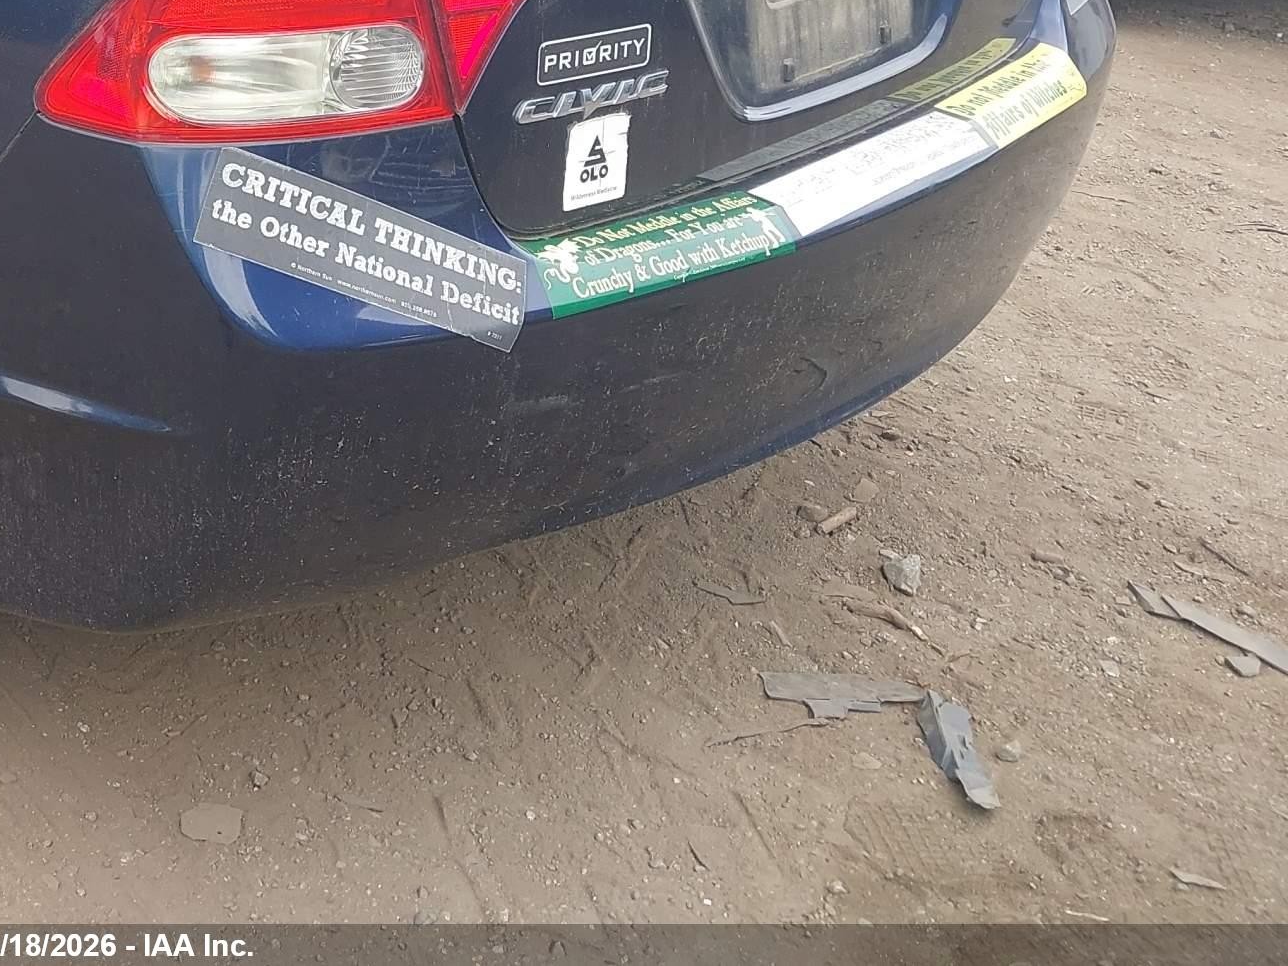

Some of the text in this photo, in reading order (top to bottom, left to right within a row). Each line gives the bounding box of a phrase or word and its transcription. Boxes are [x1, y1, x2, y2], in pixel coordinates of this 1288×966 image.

[544, 38, 646, 73] PRIORITY
[513, 70, 670, 124] CIVIC
[946, 103, 976, 116] Do
[967, 92, 992, 106] not
[981, 106, 1026, 141] Affairs
[1019, 94, 1040, 118] of
[222, 162, 522, 294] CRITICAL THINKING:
[573, 236, 605, 248] Do
[595, 228, 636, 242] Not
[625, 215, 682, 234] Meddle
[691, 206, 717, 217] the
[712, 196, 758, 213] Affairs
[584, 247, 604, 266] of
[687, 221, 724, 235] You
[211, 198, 520, 326] the Other National Deficit
[297, 264, 321, 277] Northern
[572, 268, 634, 299] Crunchy
[634, 263, 651, 282] &
[648, 249, 689, 276] Good
[687, 242, 721, 266] with
[715, 232, 772, 257] Ketchup
